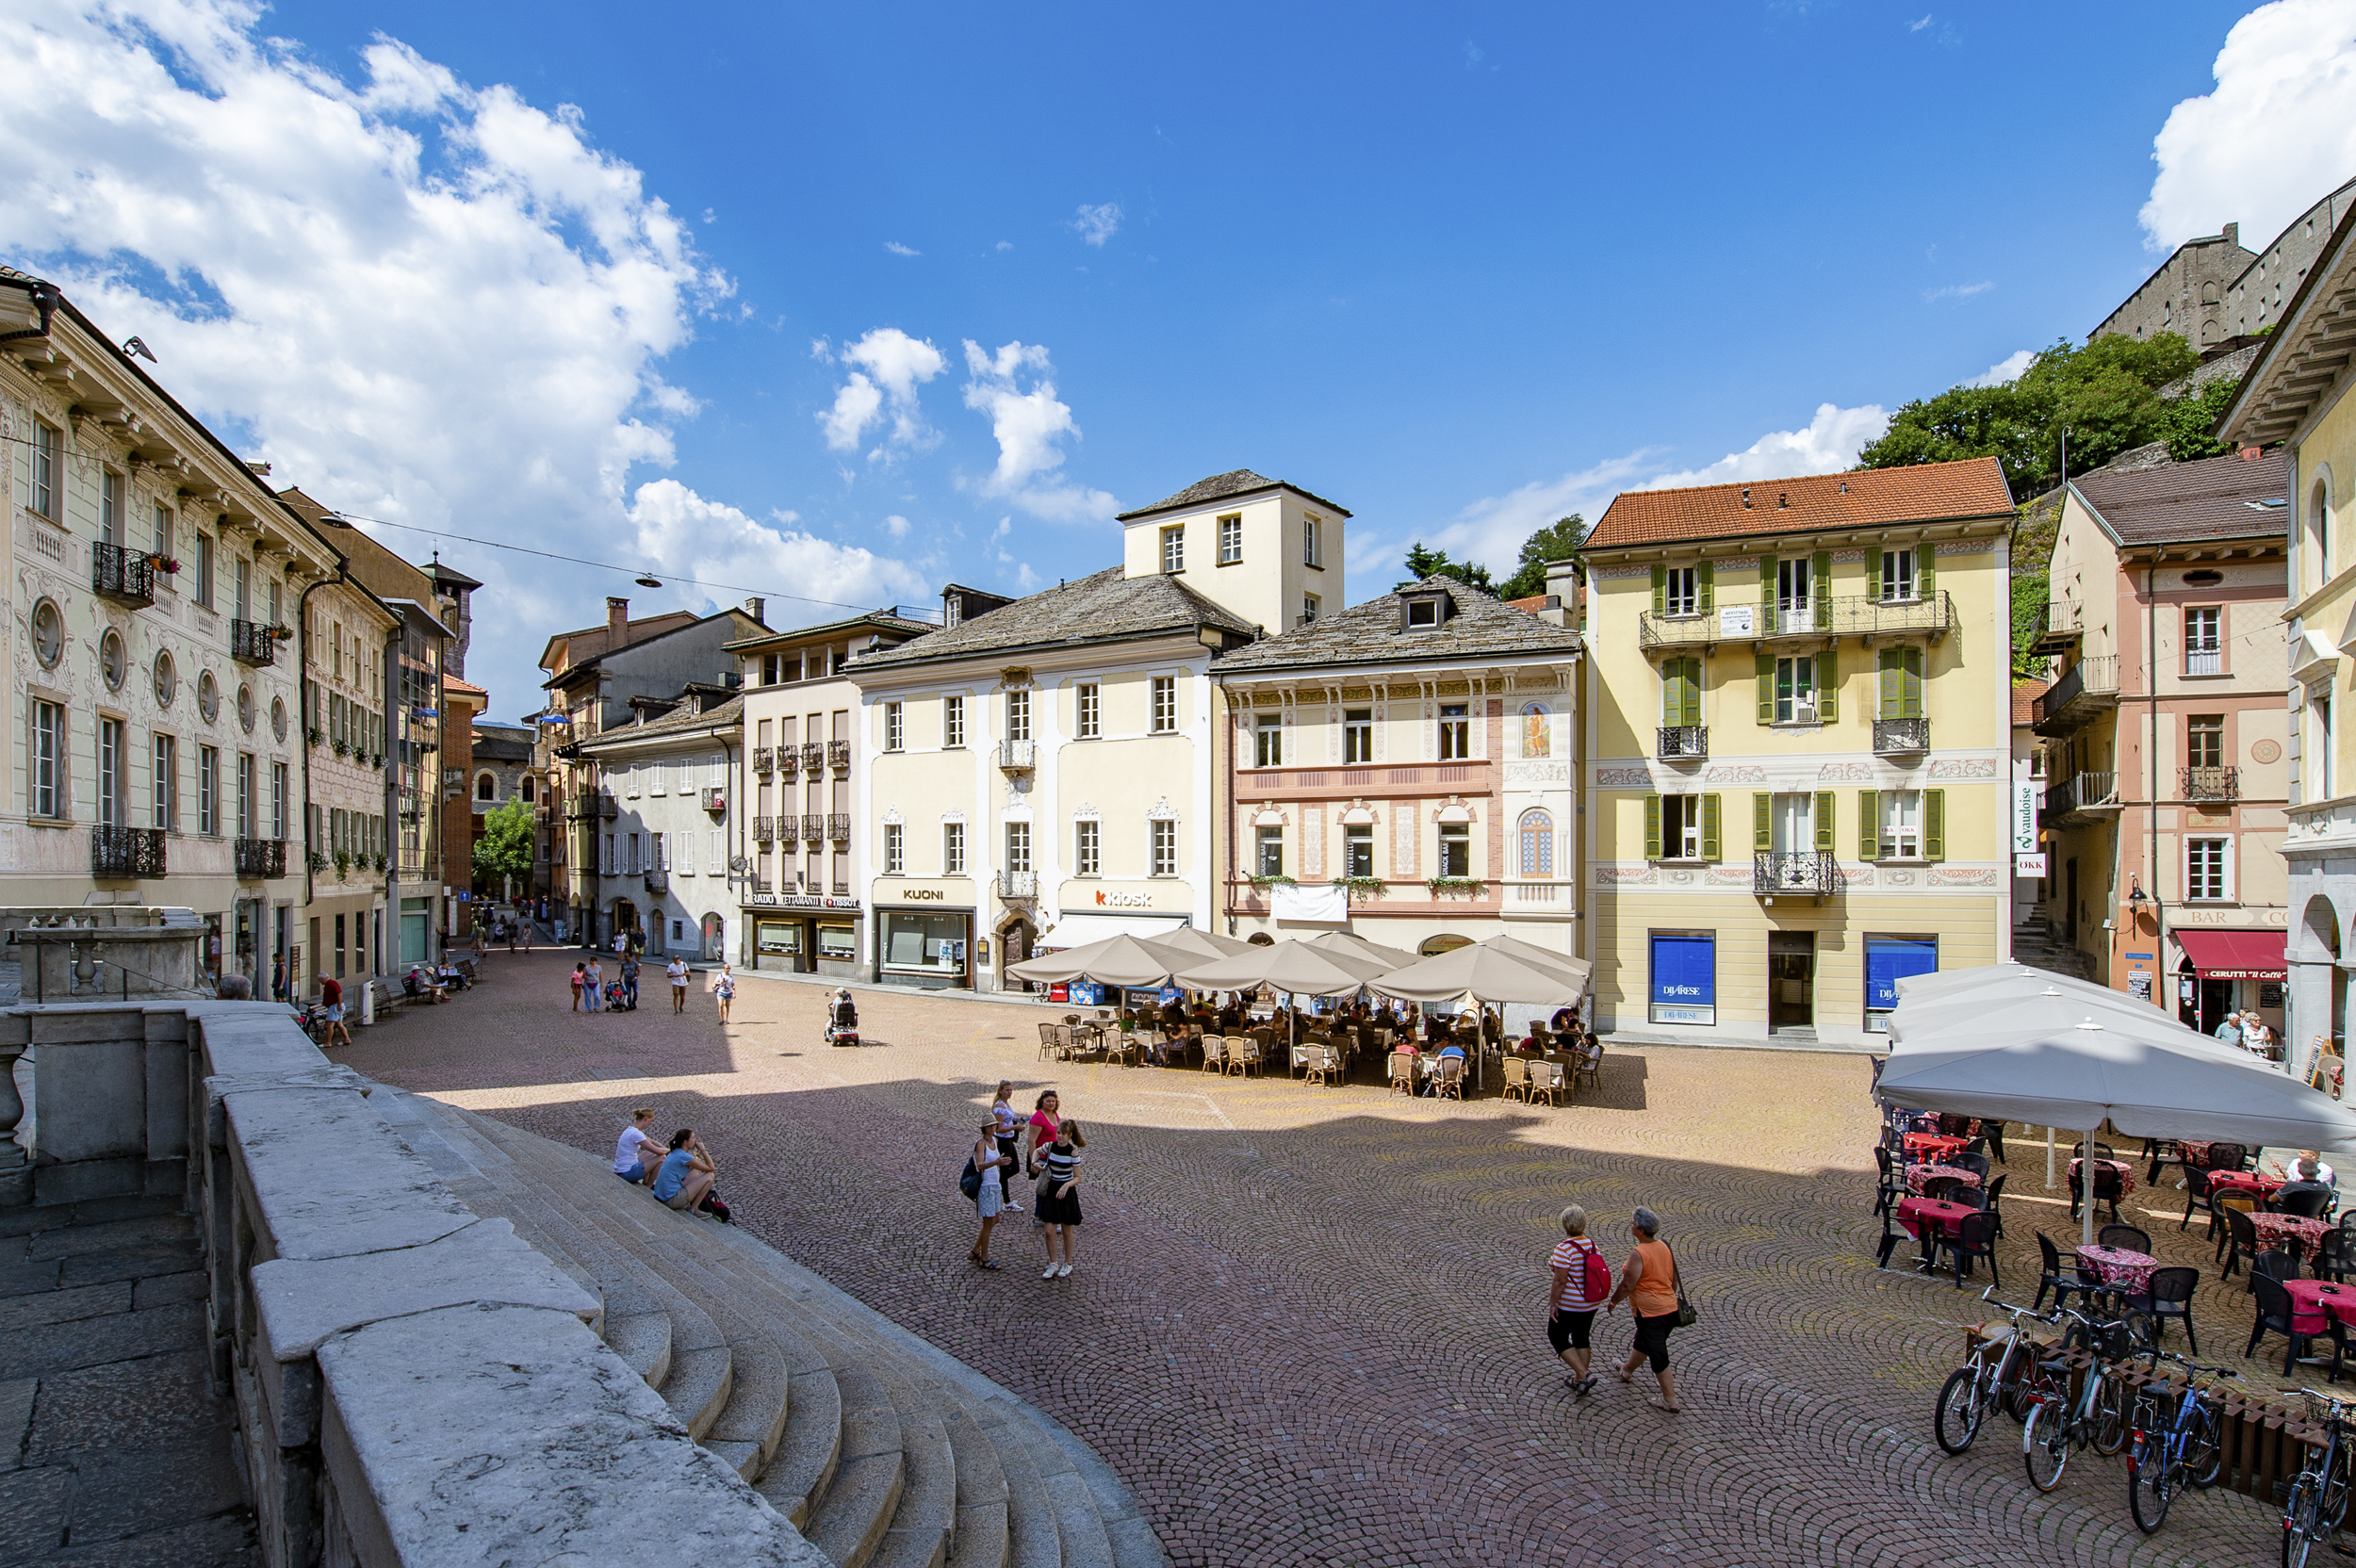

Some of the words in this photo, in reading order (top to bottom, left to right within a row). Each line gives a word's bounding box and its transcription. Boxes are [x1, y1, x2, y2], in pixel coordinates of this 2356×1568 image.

[2019, 788, 2031, 834] vaudoise
[753, 893, 775, 904] RADO
[903, 890, 943, 900] KUONI
[1107, 890, 1153, 906] kiosk
[832, 898, 858, 906] TISSOT
[2191, 911, 2227, 923] BAR
